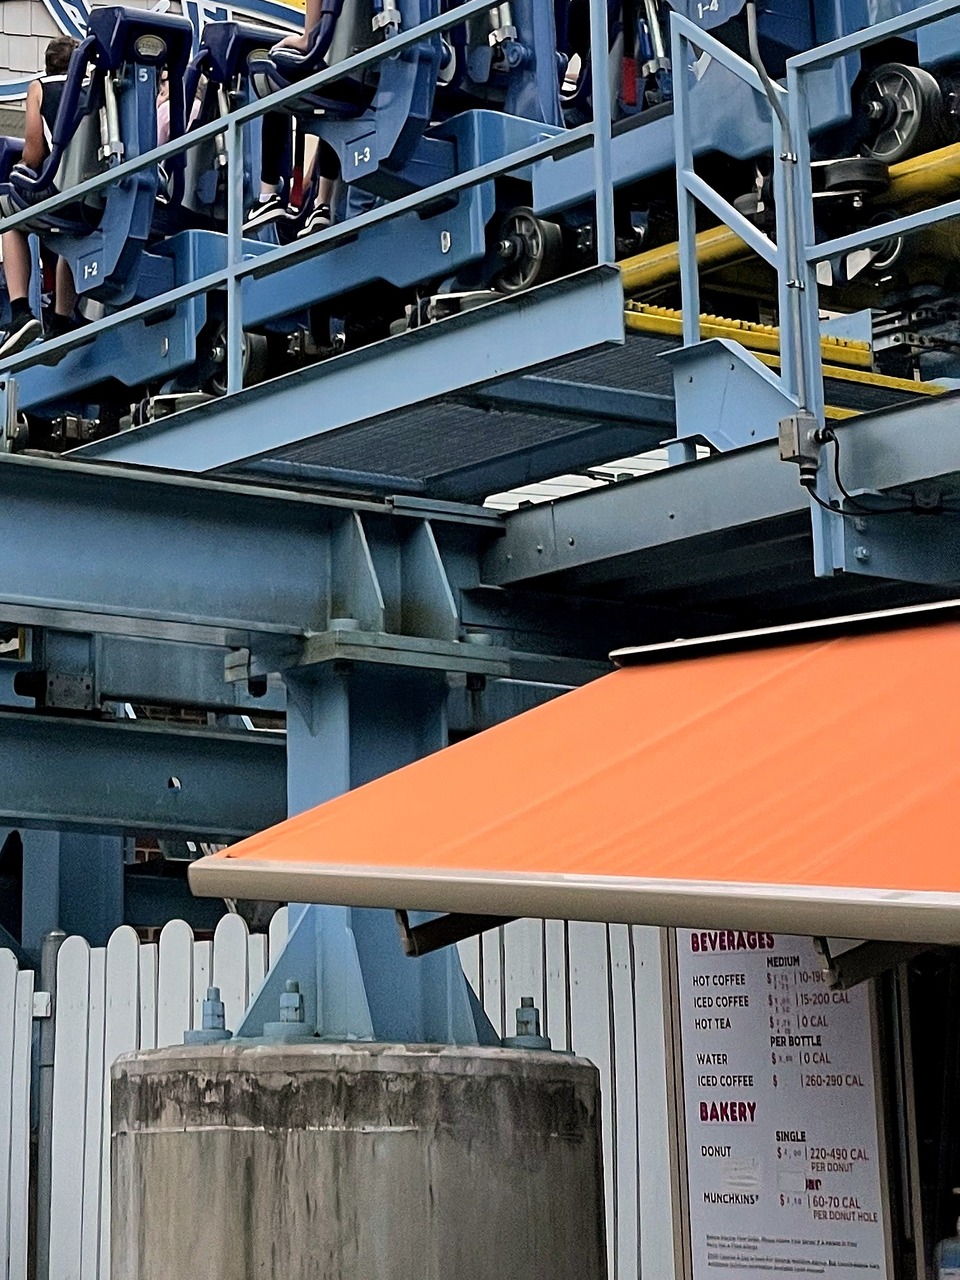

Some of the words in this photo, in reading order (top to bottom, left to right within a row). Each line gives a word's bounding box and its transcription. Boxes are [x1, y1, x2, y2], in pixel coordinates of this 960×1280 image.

[138, 67, 148, 82] 5
[354, 146, 370, 167] 1-3
[84, 261, 98, 280] 1-2
[691, 929, 775, 952] BEVERAGES
[767, 956, 800, 968] MEDIUM
[692, 975, 710, 986] HOT
[712, 974, 745, 986] COFFEE
[694, 997, 713, 1008] ICED
[716, 995, 749, 1007] COFFEE
[801, 992, 830, 1005] 15-200
[832, 992, 851, 1004] CAL
[695, 1019, 714, 1029] HOT
[715, 1018, 732, 1029] TEA
[810, 1015, 829, 1027] CAL
[770, 1036, 787, 1047] PER
[788, 1035, 822, 1046] BOTTLE
[696, 1053, 728, 1065] WATER
[812, 1052, 831, 1064] CAL
[697, 1075, 718, 1087] ICED
[720, 1075, 754, 1086] COFFEE
[805, 1075, 843, 1087] 260-290
[845, 1074, 864, 1086] CAL
[699, 1101, 757, 1122] BAKERY
[775, 1131, 806, 1143] SINGLE
[701, 1146, 731, 1157] DONUT
[810, 1148, 848, 1160] 220-490
[850, 1149, 869, 1160] CAL
[811, 1162, 826, 1172] PER
[827, 1163, 854, 1173] DONUT
[813, 1195, 840, 1208] 60-70
[842, 1197, 861, 1209] CAL
[813, 1210, 828, 1220] PER
[829, 1211, 855, 1221] DONUT
[857, 1212, 878, 1223] HOLE
